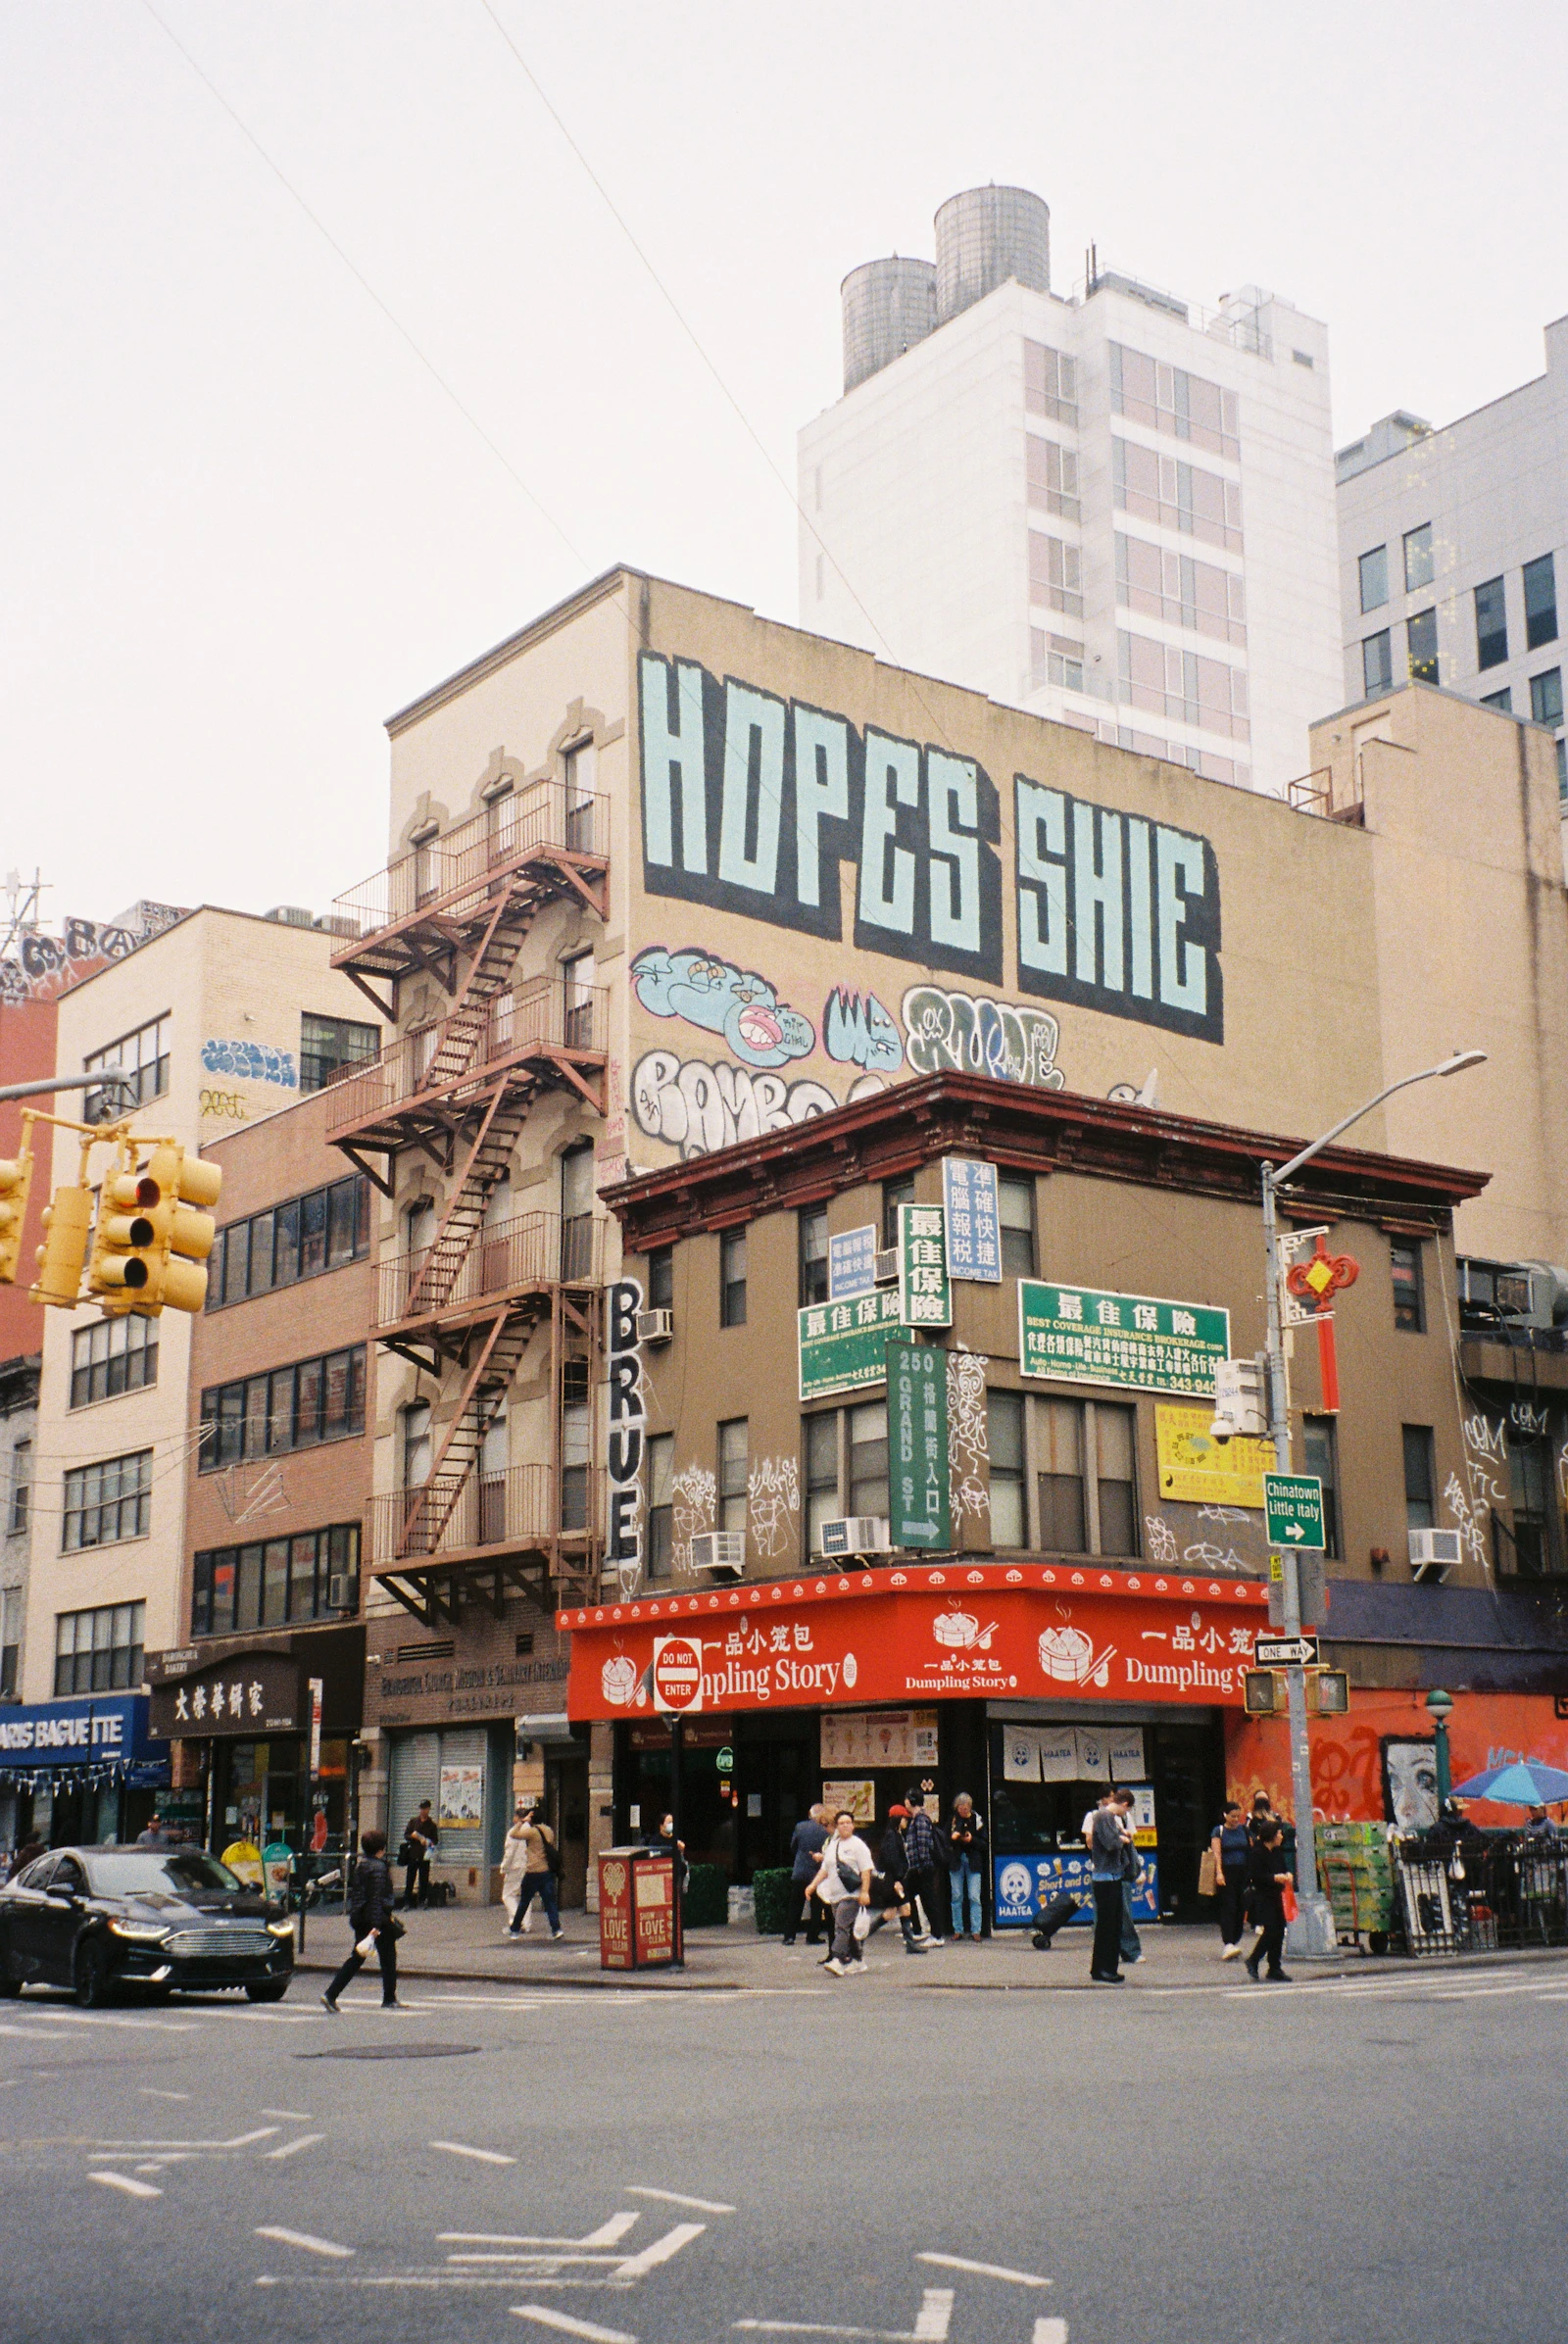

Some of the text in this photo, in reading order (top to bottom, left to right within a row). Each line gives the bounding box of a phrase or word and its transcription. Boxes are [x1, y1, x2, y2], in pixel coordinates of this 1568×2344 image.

[637, 650, 1004, 988] HOPES
[951, 1265, 998, 1279] INCOME TAX
[1058, 1293, 1196, 1337] 最佳保險
[1027, 1316, 1051, 1328] BEST
[1053, 1320, 1102, 1336] COVERAGE
[1103, 1328, 1152, 1343] INSURANCE
[1154, 1334, 1205, 1349] BROKERAGE
[900, 1350, 934, 1373] 250
[899, 1375, 914, 1512] GRAND ST
[1267, 1481, 1320, 1500] Chinatown
[1268, 1500, 1320, 1521] Little Italy
[662, 1652, 693, 1665] DO NOT
[1263, 1645, 1310, 1658] ONE WAY
[775, 1658, 841, 1695] Story
[906, 1675, 1008, 1691] Dumpling Story
[1125, 1657, 1234, 1695] Dumpling
[664, 1684, 692, 1696] ENTER
[35, 1715, 123, 1747] BAGUETTE
[1039, 1878, 1063, 1891] Short
[1064, 1876, 1082, 1887] and
[999, 1906, 1033, 1917] HAATEA
[604, 1920, 627, 1940] LOVE
[639, 1920, 664, 1936] LOVE
